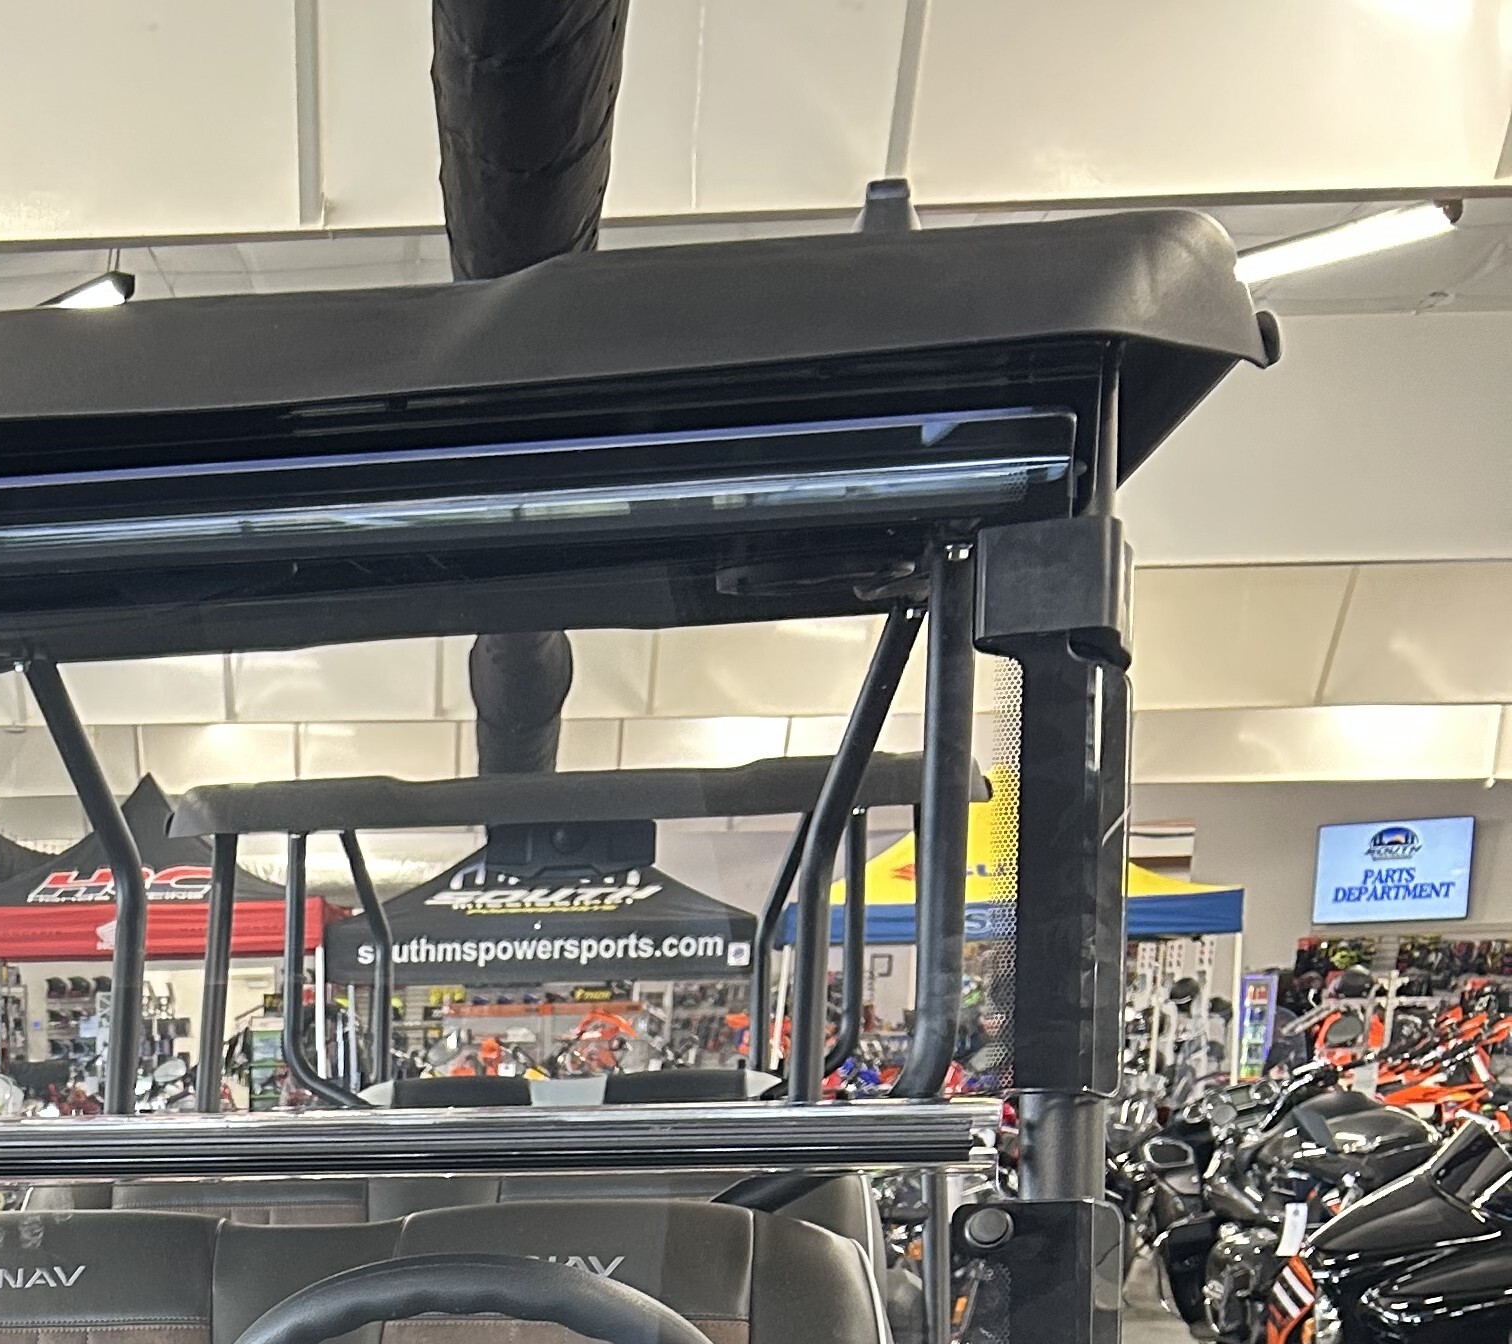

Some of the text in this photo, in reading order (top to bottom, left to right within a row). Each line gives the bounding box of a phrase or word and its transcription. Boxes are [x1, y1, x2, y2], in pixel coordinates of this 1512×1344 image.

[28, 865, 212, 899] HC
[1362, 867, 1416, 885] PARTS
[424, 884, 663, 907] SOUTH
[1332, 882, 1456, 903] DEPARTMENT
[358, 933, 724, 967] suthmspowersports.com
